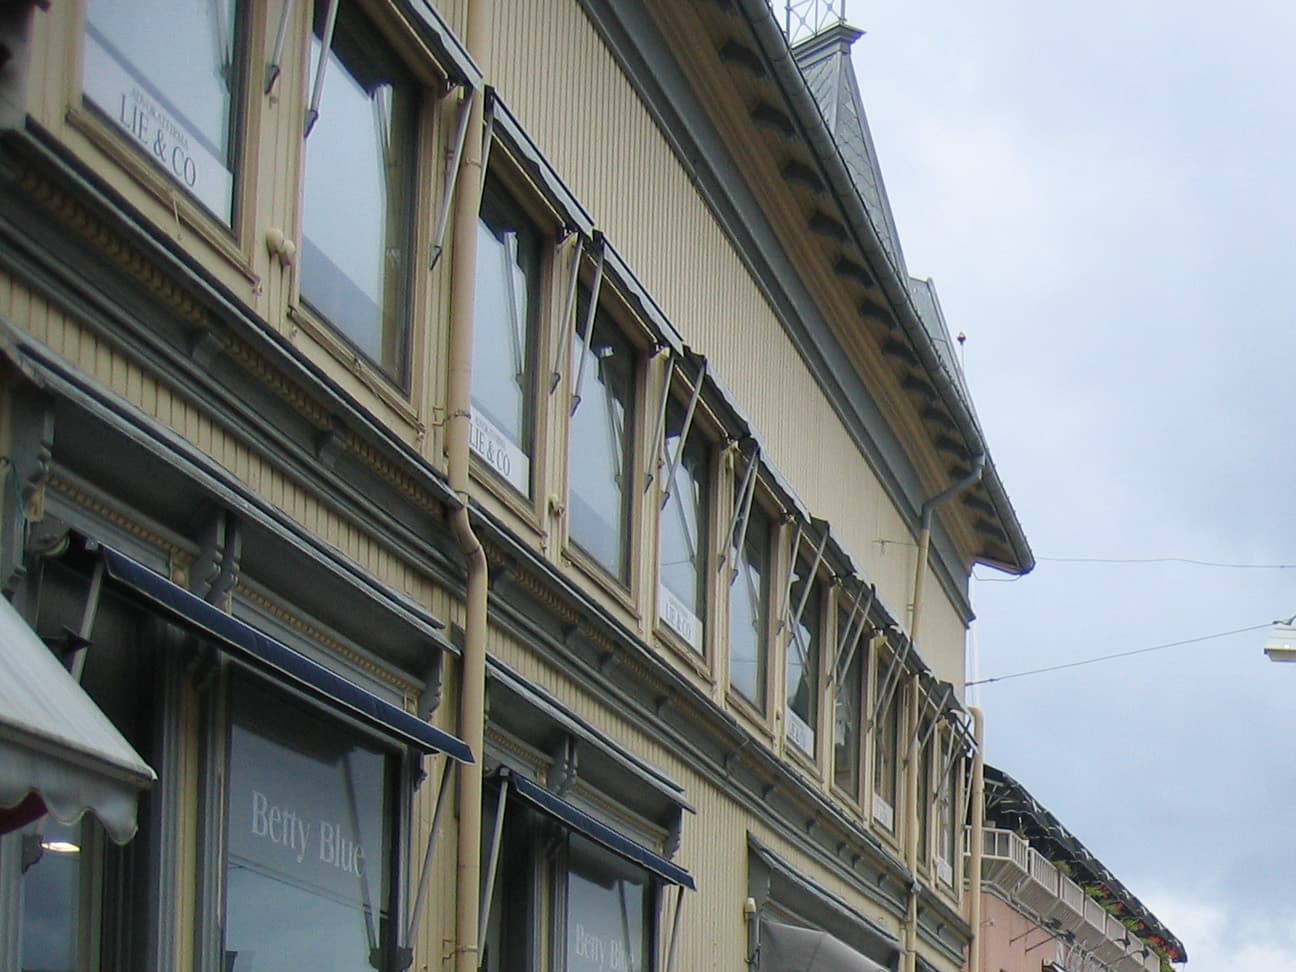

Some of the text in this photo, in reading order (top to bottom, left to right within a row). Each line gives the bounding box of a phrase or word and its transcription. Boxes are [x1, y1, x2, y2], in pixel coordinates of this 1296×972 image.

[120, 93, 196, 188] LIE & CO
[496, 448, 511, 477] CO
[251, 789, 366, 878] Betty Blue
